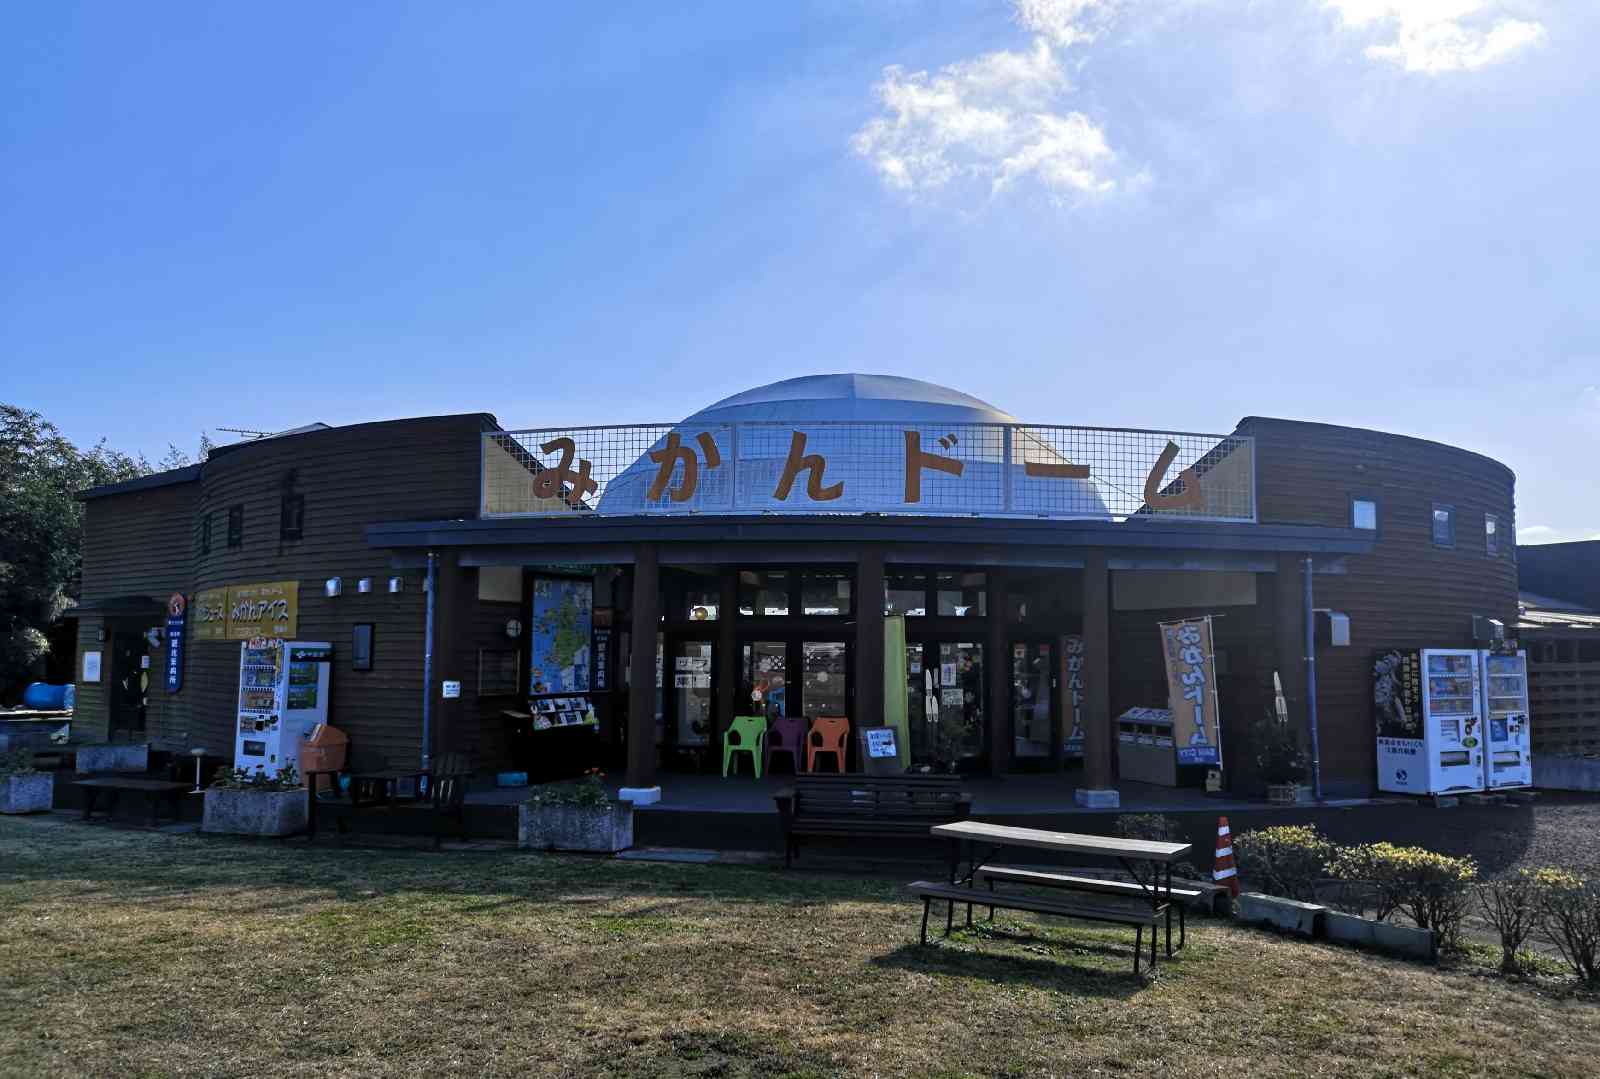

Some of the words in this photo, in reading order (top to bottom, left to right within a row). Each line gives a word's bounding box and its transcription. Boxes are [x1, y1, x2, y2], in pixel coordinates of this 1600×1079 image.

[532, 431, 1202, 508] みかんドーム
